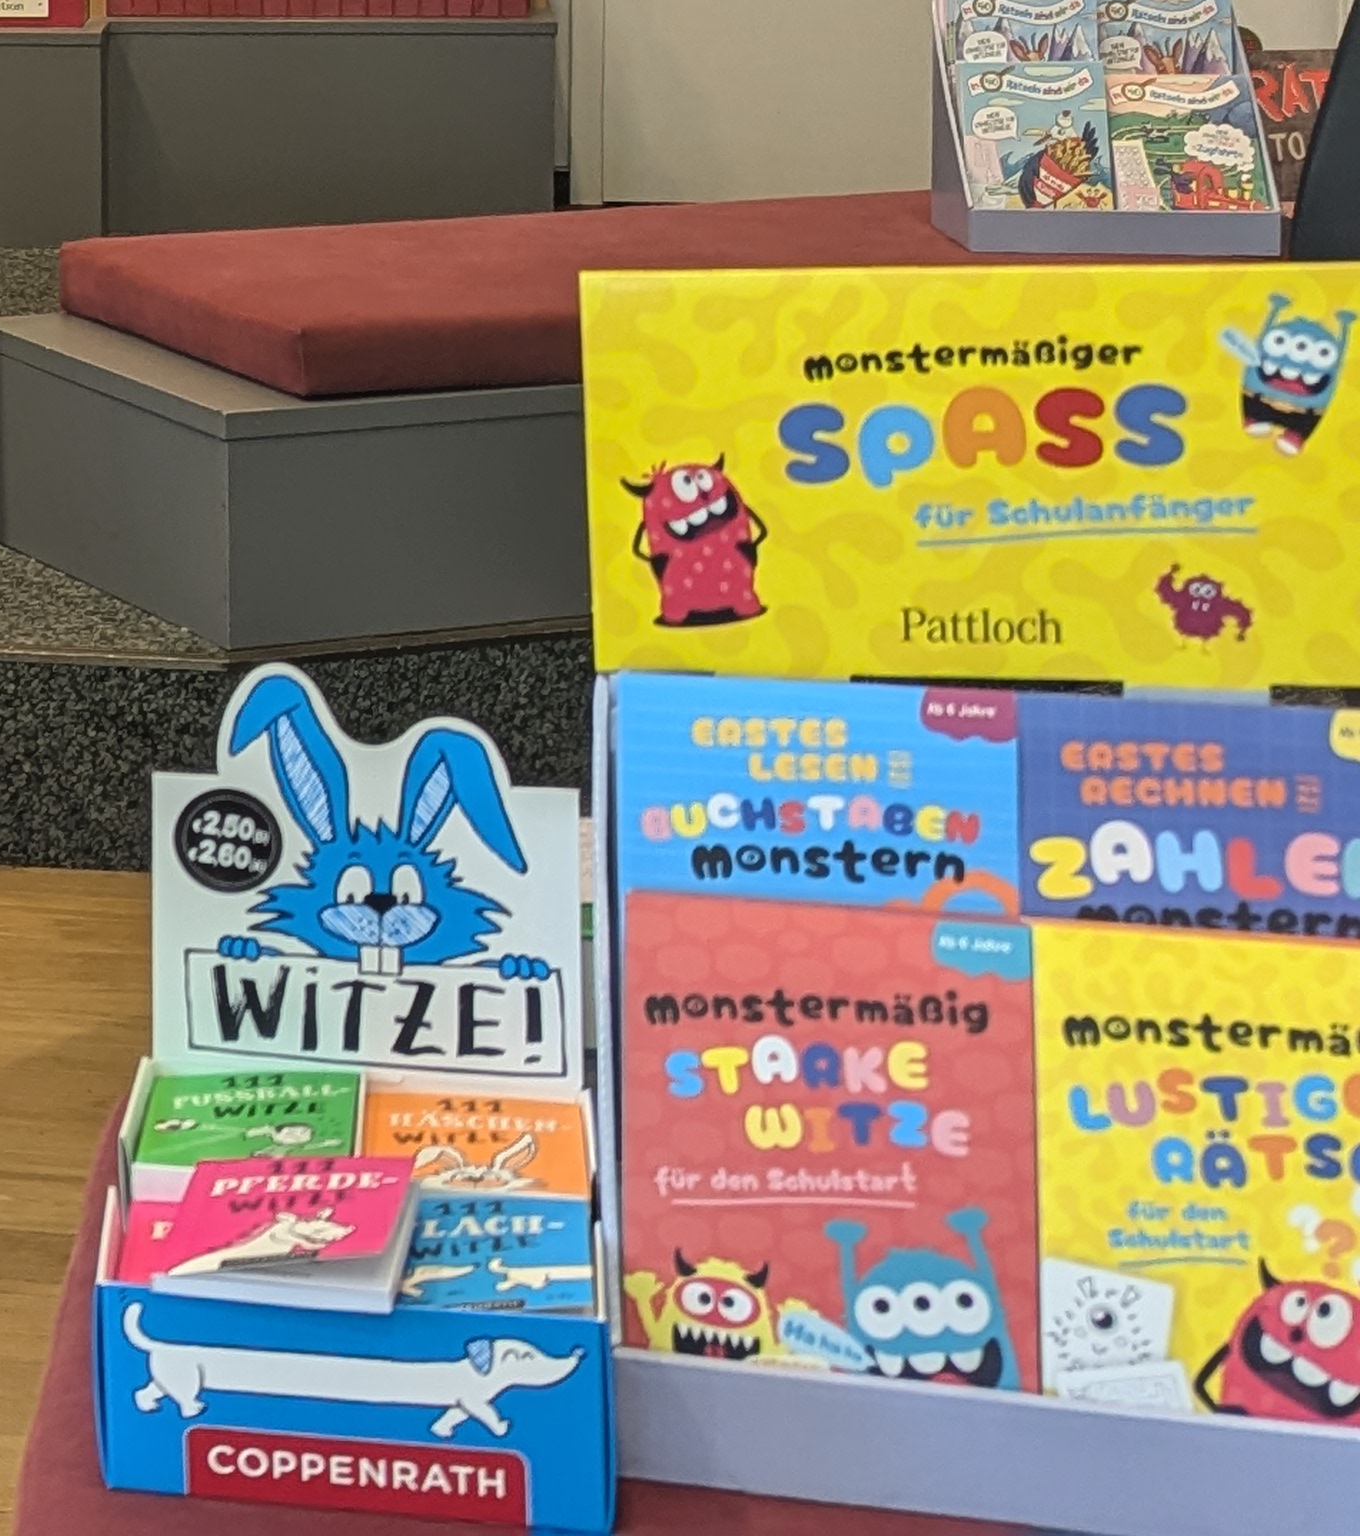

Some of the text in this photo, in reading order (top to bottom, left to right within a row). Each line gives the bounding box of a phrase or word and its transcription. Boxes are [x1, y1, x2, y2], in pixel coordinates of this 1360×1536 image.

[1250, 62, 1331, 122] RÄT
[802, 335, 1145, 383] monstermäßiger
[915, 493, 1257, 531] für Schulanfänger
[900, 606, 1063, 648] Pattloch
[748, 752, 879, 783] LESEN
[1079, 774, 1287, 809] RECHNEN
[640, 792, 981, 844] BUCHSTABEN
[691, 840, 966, 884] monstern
[644, 988, 990, 1033] monstermäßig
[1062, 1013, 1360, 1057] monstermä
[221, 1074, 286, 1089] 111
[664, 1035, 931, 1100] STARKE
[173, 1083, 352, 1111] FUSSBALL-
[213, 1100, 327, 1119] WITZE
[437, 1098, 503, 1113] 111
[388, 1110, 573, 1134] HÄSCHEN-
[744, 1099, 972, 1158] WITZE
[393, 1130, 510, 1146] WITZE
[268, 1158, 336, 1175] 111
[654, 1161, 919, 1197] für den Schulstart
[210, 1171, 400, 1198] PFERDE-
[227, 1190, 356, 1213] WITZE
[433, 1201, 506, 1216] 111
[1127, 1200, 1228, 1222] für den
[420, 1214, 566, 1240] LACH-
[1107, 1227, 1252, 1252] Schulstart
[410, 1236, 541, 1260] WITZE
[206, 1443, 508, 1500] COPPENRATH
